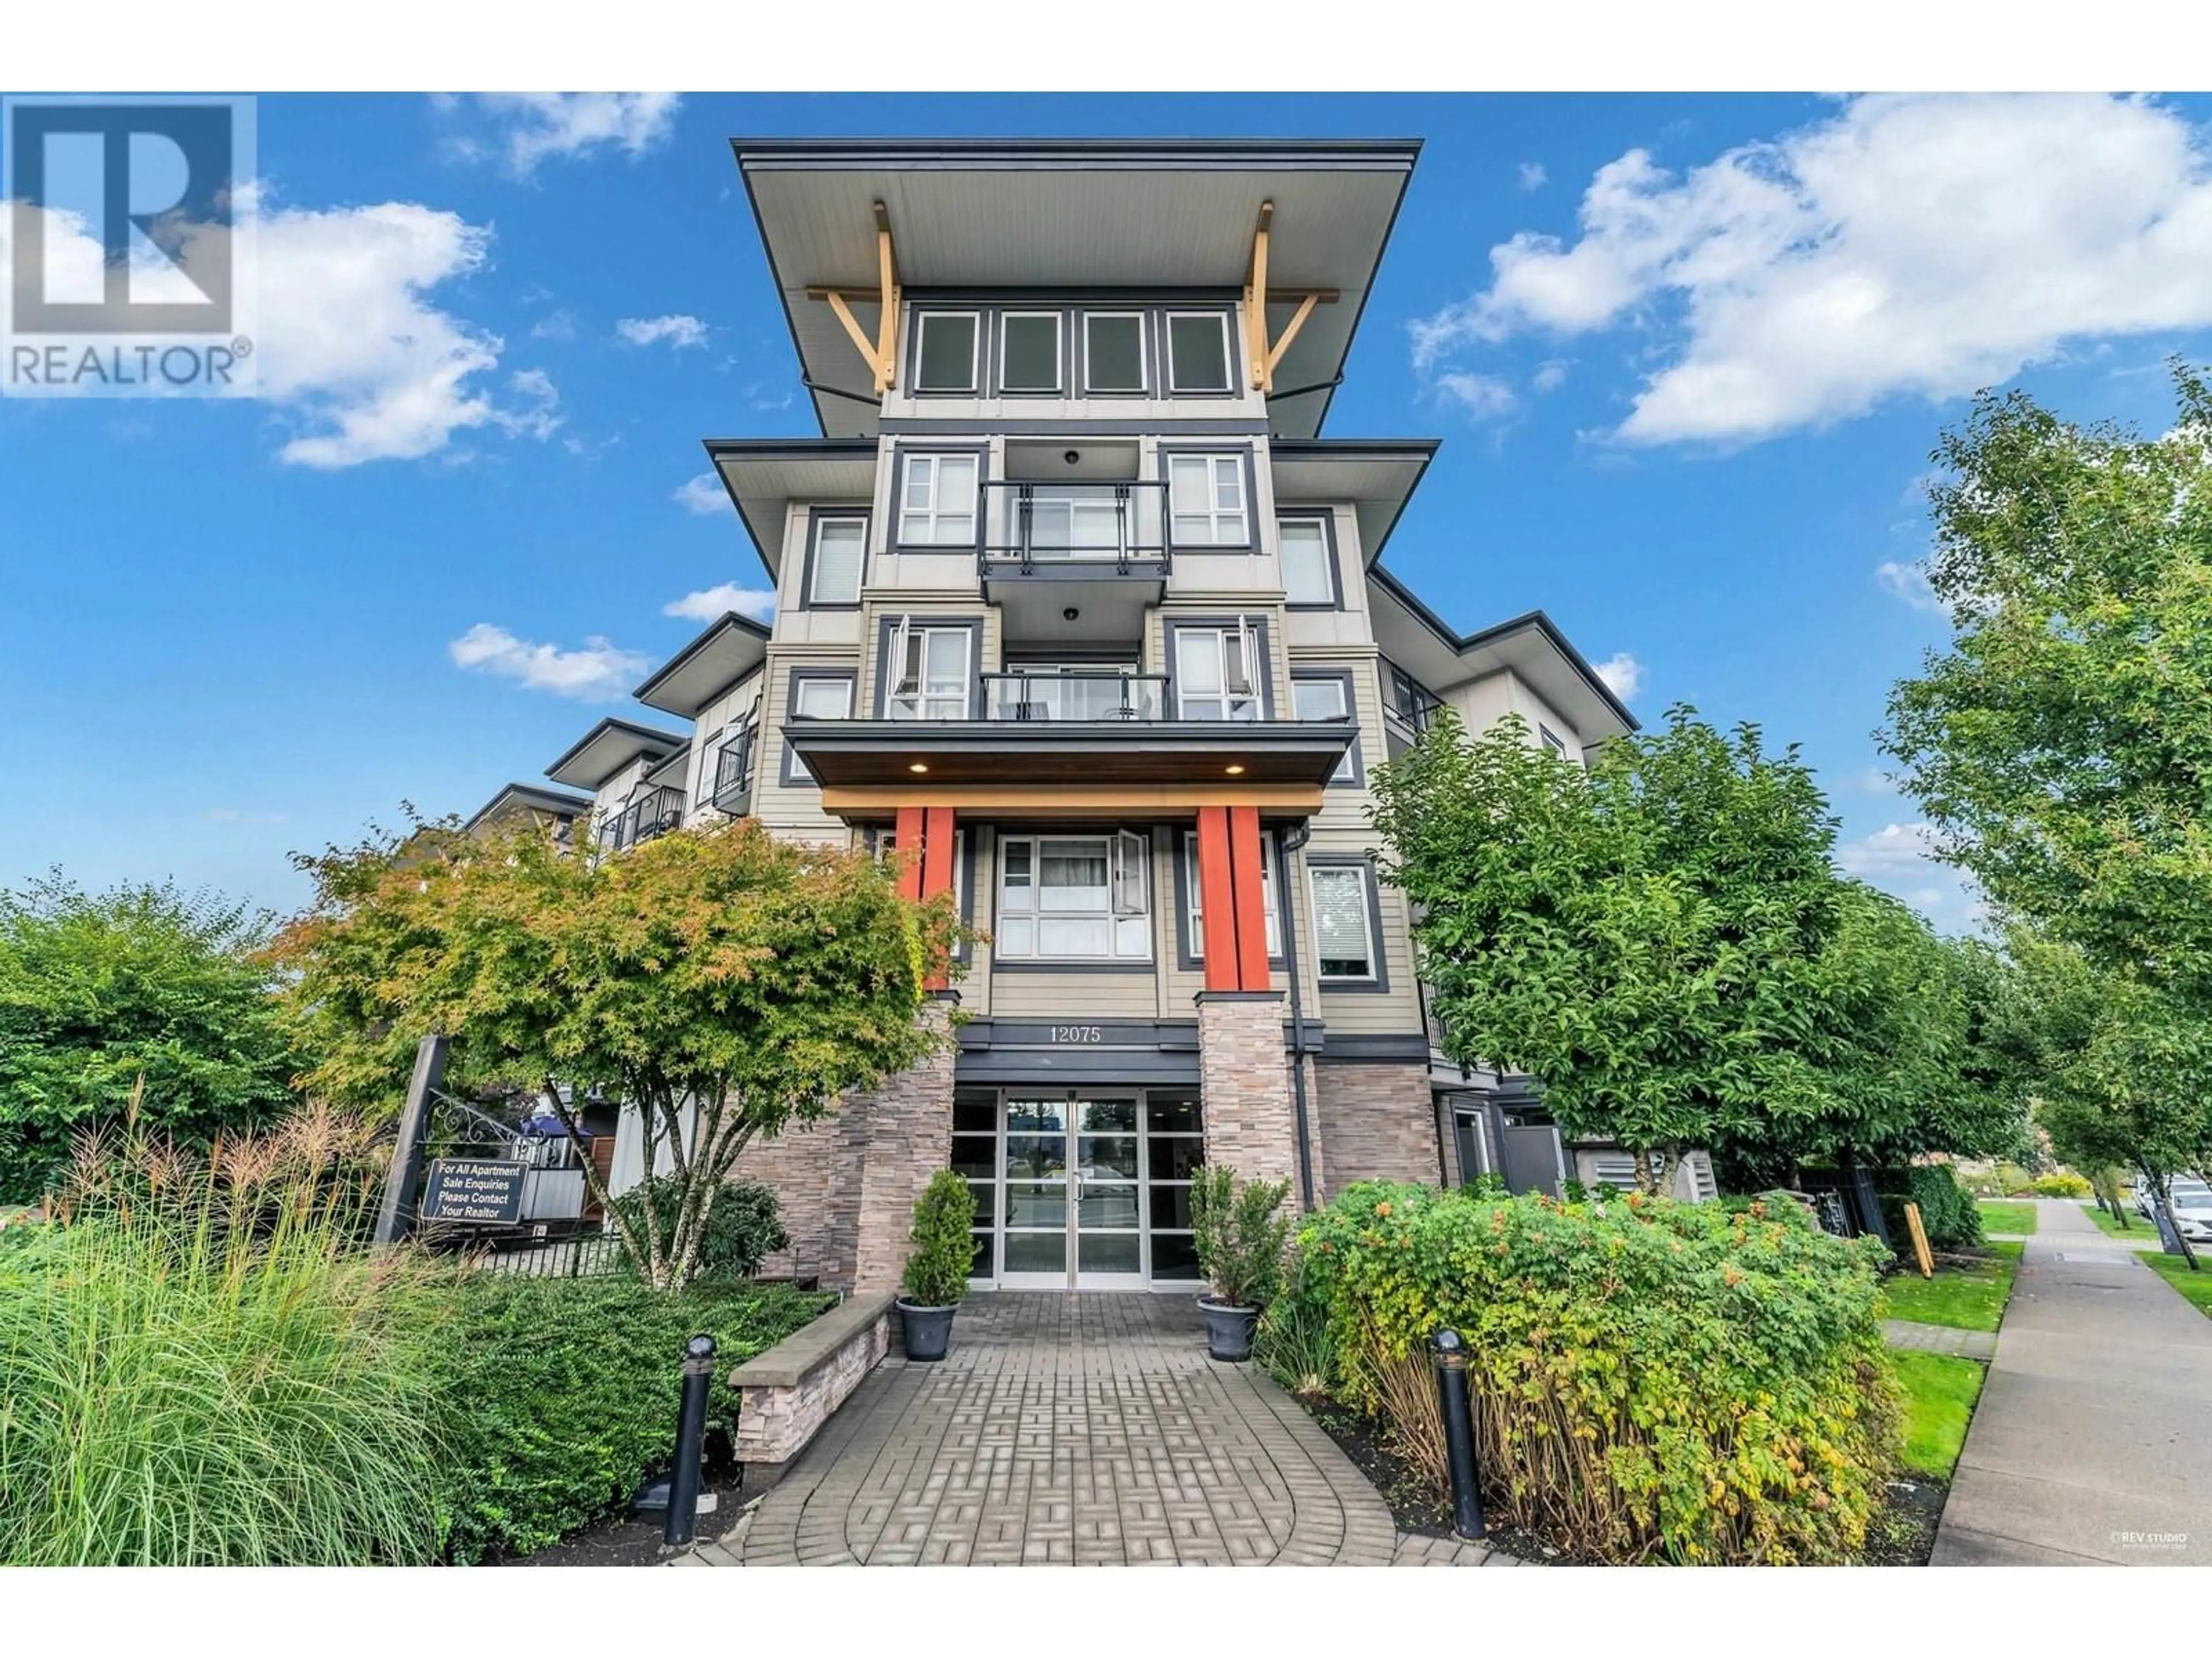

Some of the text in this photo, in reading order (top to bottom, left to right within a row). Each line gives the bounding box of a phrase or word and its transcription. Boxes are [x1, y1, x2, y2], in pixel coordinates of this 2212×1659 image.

[1051, 1027, 1100, 1042] 12075
[439, 1164, 520, 1176] For All Apartment
[442, 1177, 510, 1191] Sale Enquiries
[438, 1191, 509, 1205] Please Contact
[442, 1206, 500, 1218] Your Realtor
